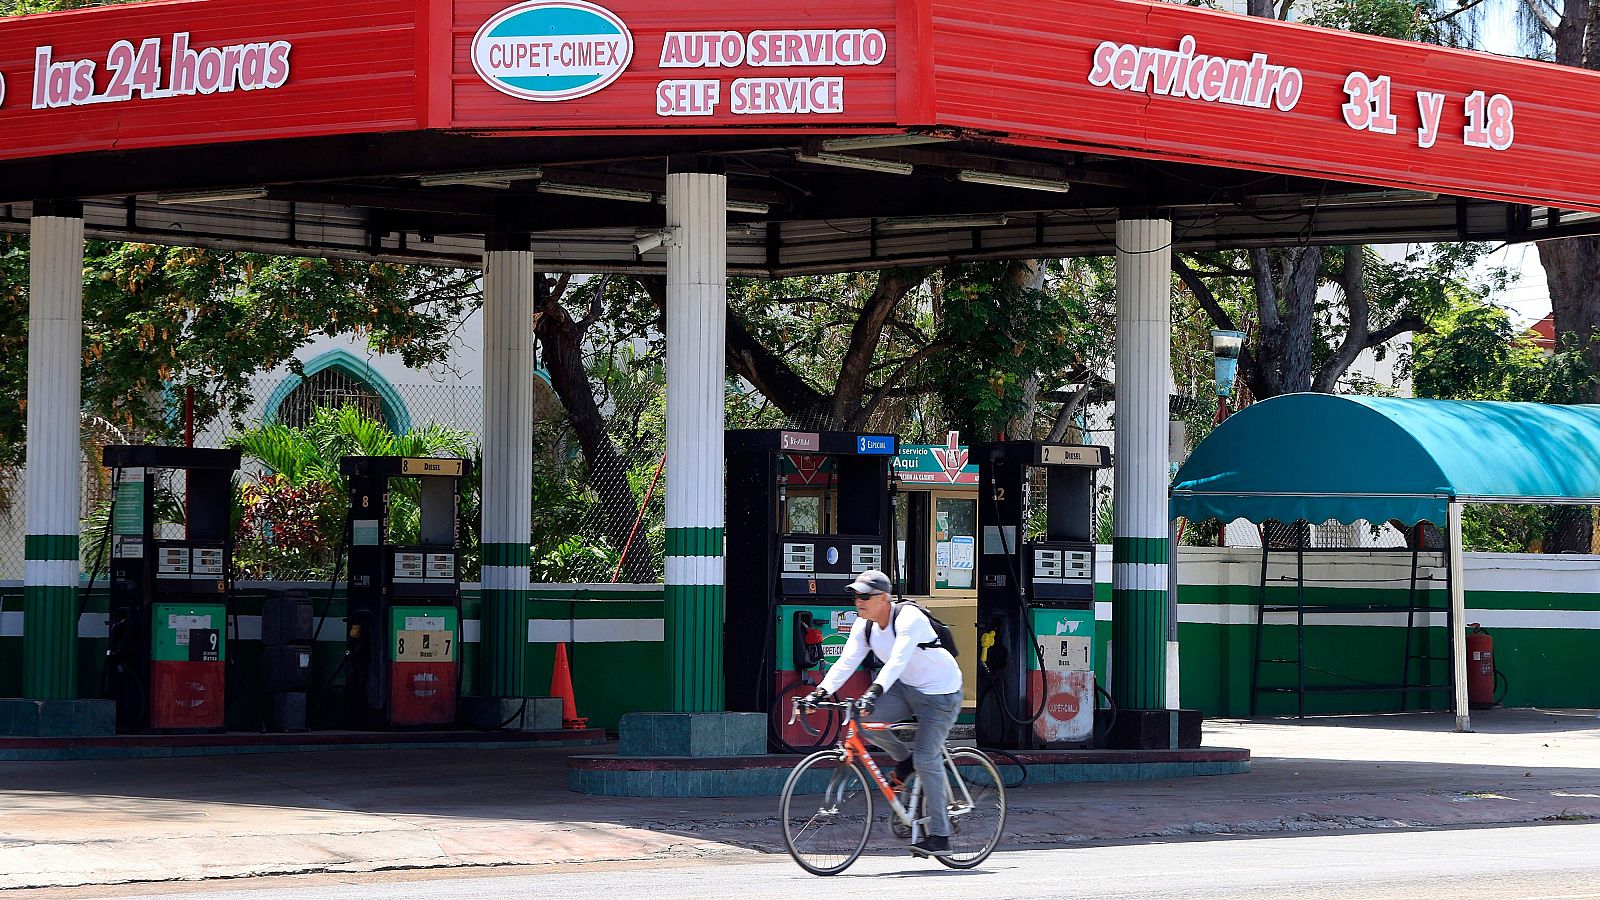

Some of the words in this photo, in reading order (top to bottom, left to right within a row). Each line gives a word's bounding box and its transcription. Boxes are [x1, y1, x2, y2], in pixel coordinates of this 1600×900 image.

[489, 41, 620, 69] CUPET-CIMEX
[660, 31, 744, 67] AUTO
[747, 30, 886, 66] SERVICIO
[32, 46, 96, 109] las
[105, 38, 161, 100] 24
[172, 32, 292, 97] horas
[657, 80, 720, 116] SELF
[731, 78, 843, 114] SERVICE
[1088, 35, 1302, 111] servicentro
[1342, 71, 1397, 134] 31
[1417, 91, 1445, 148] y
[1464, 89, 1514, 150] 18
[783, 434, 789, 449] 5
[860, 437, 866, 452] 3
[902, 447, 928, 455] servicio
[1044, 447, 1050, 462] 2
[1095, 450, 1099, 463] 1
[403, 460, 408, 472] 8
[456, 462, 461, 474] 7
[893, 456, 919, 470] Aquí
[362, 495, 369, 508] 8
[997, 487, 1005, 501] 2
[209, 633, 218, 651] 9
[398, 638, 405, 655] 8
[444, 639, 451, 655] 7
[1083, 646, 1088, 663] 1
